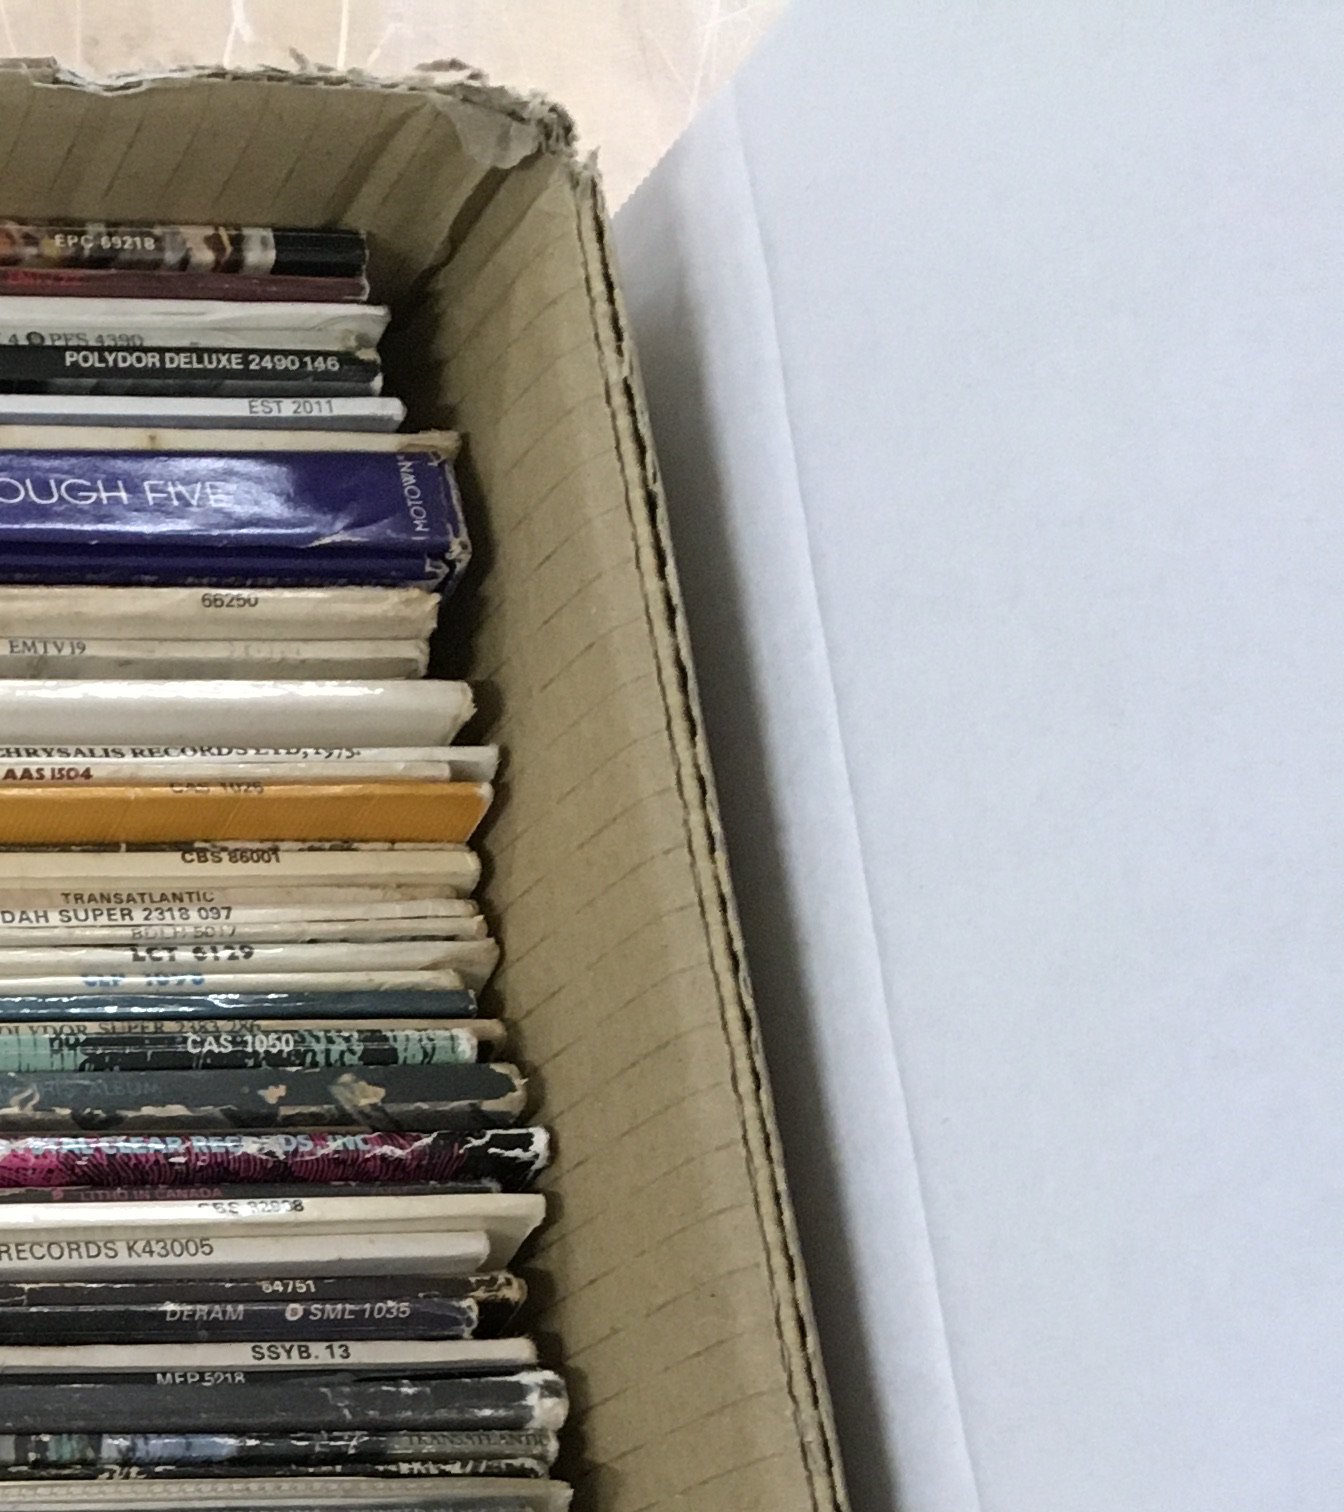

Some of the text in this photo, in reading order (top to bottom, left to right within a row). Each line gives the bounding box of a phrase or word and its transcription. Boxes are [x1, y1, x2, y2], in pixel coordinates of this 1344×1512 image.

[65, 351, 340, 373] POLYDOR DELUXE 2490 146
[248, 399, 335, 415] EST 2011
[126, 1240, 213, 1258] K43005
[324, 1344, 351, 1360] 13
